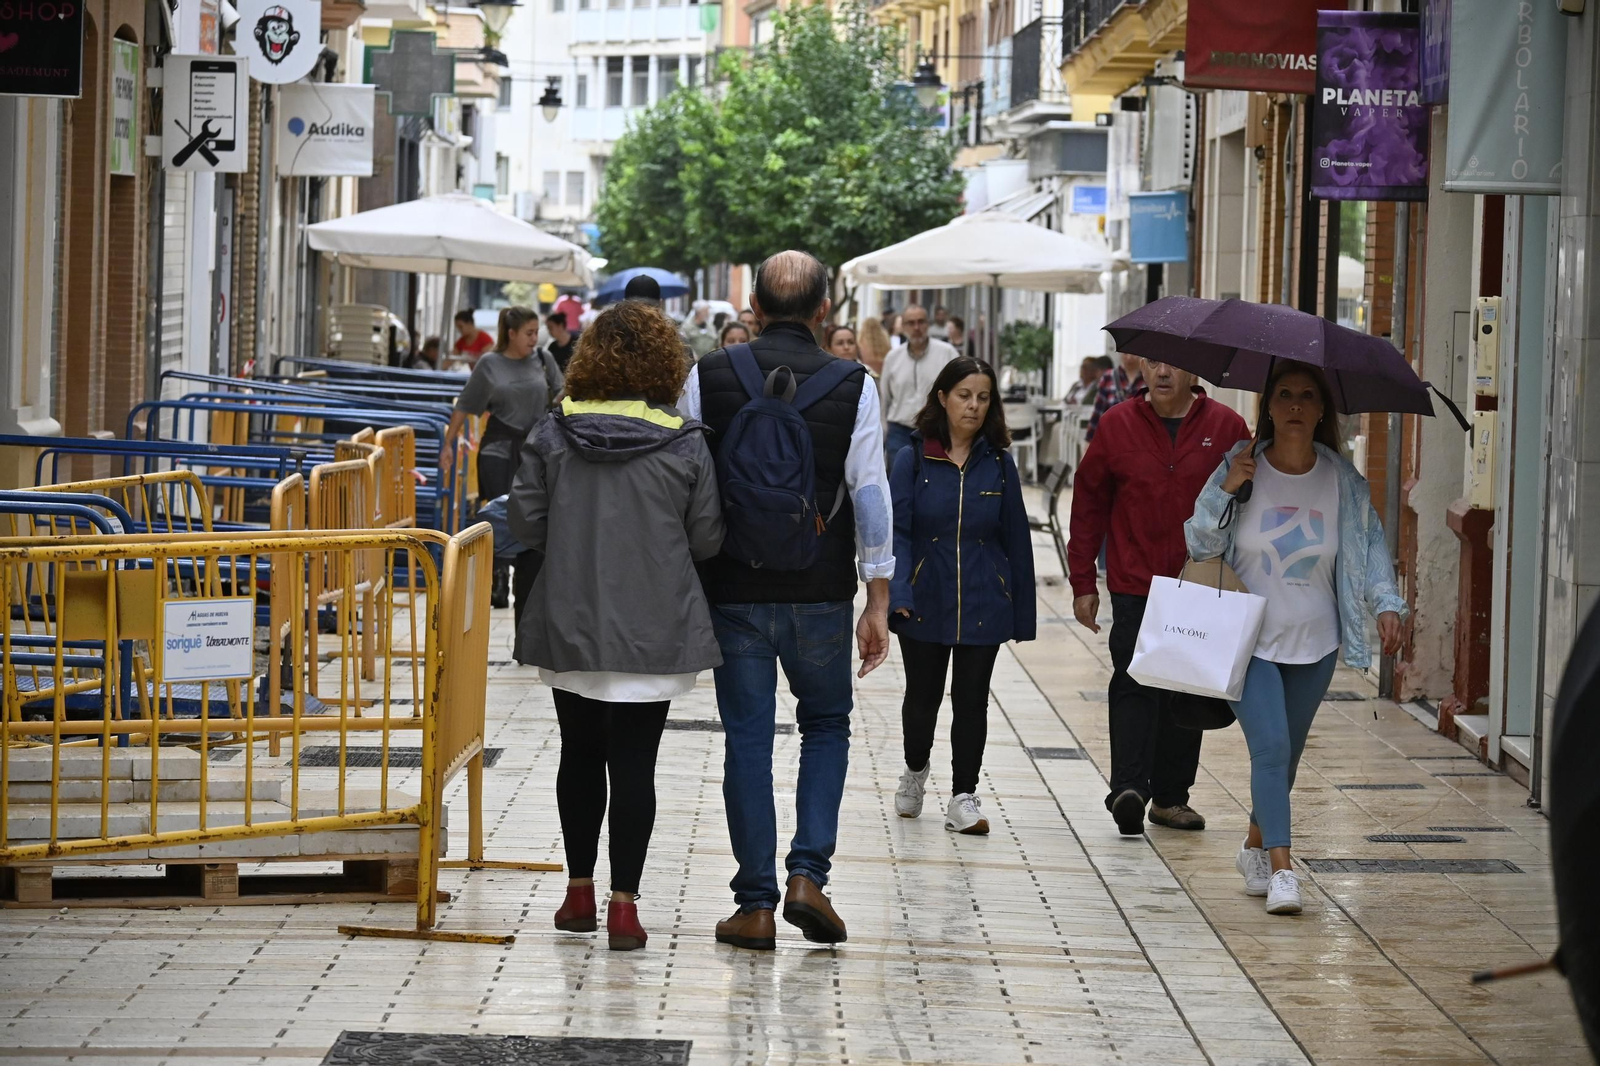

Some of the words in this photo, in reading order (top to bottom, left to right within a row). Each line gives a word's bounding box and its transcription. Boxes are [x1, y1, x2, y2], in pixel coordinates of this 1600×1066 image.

[0, 1, 75, 20] SHOP
[1210, 51, 1317, 71] PRONOVIAS
[1322, 88, 1421, 107] PLANETA
[1341, 107, 1403, 117] VAPER
[308, 122, 364, 137] Audika
